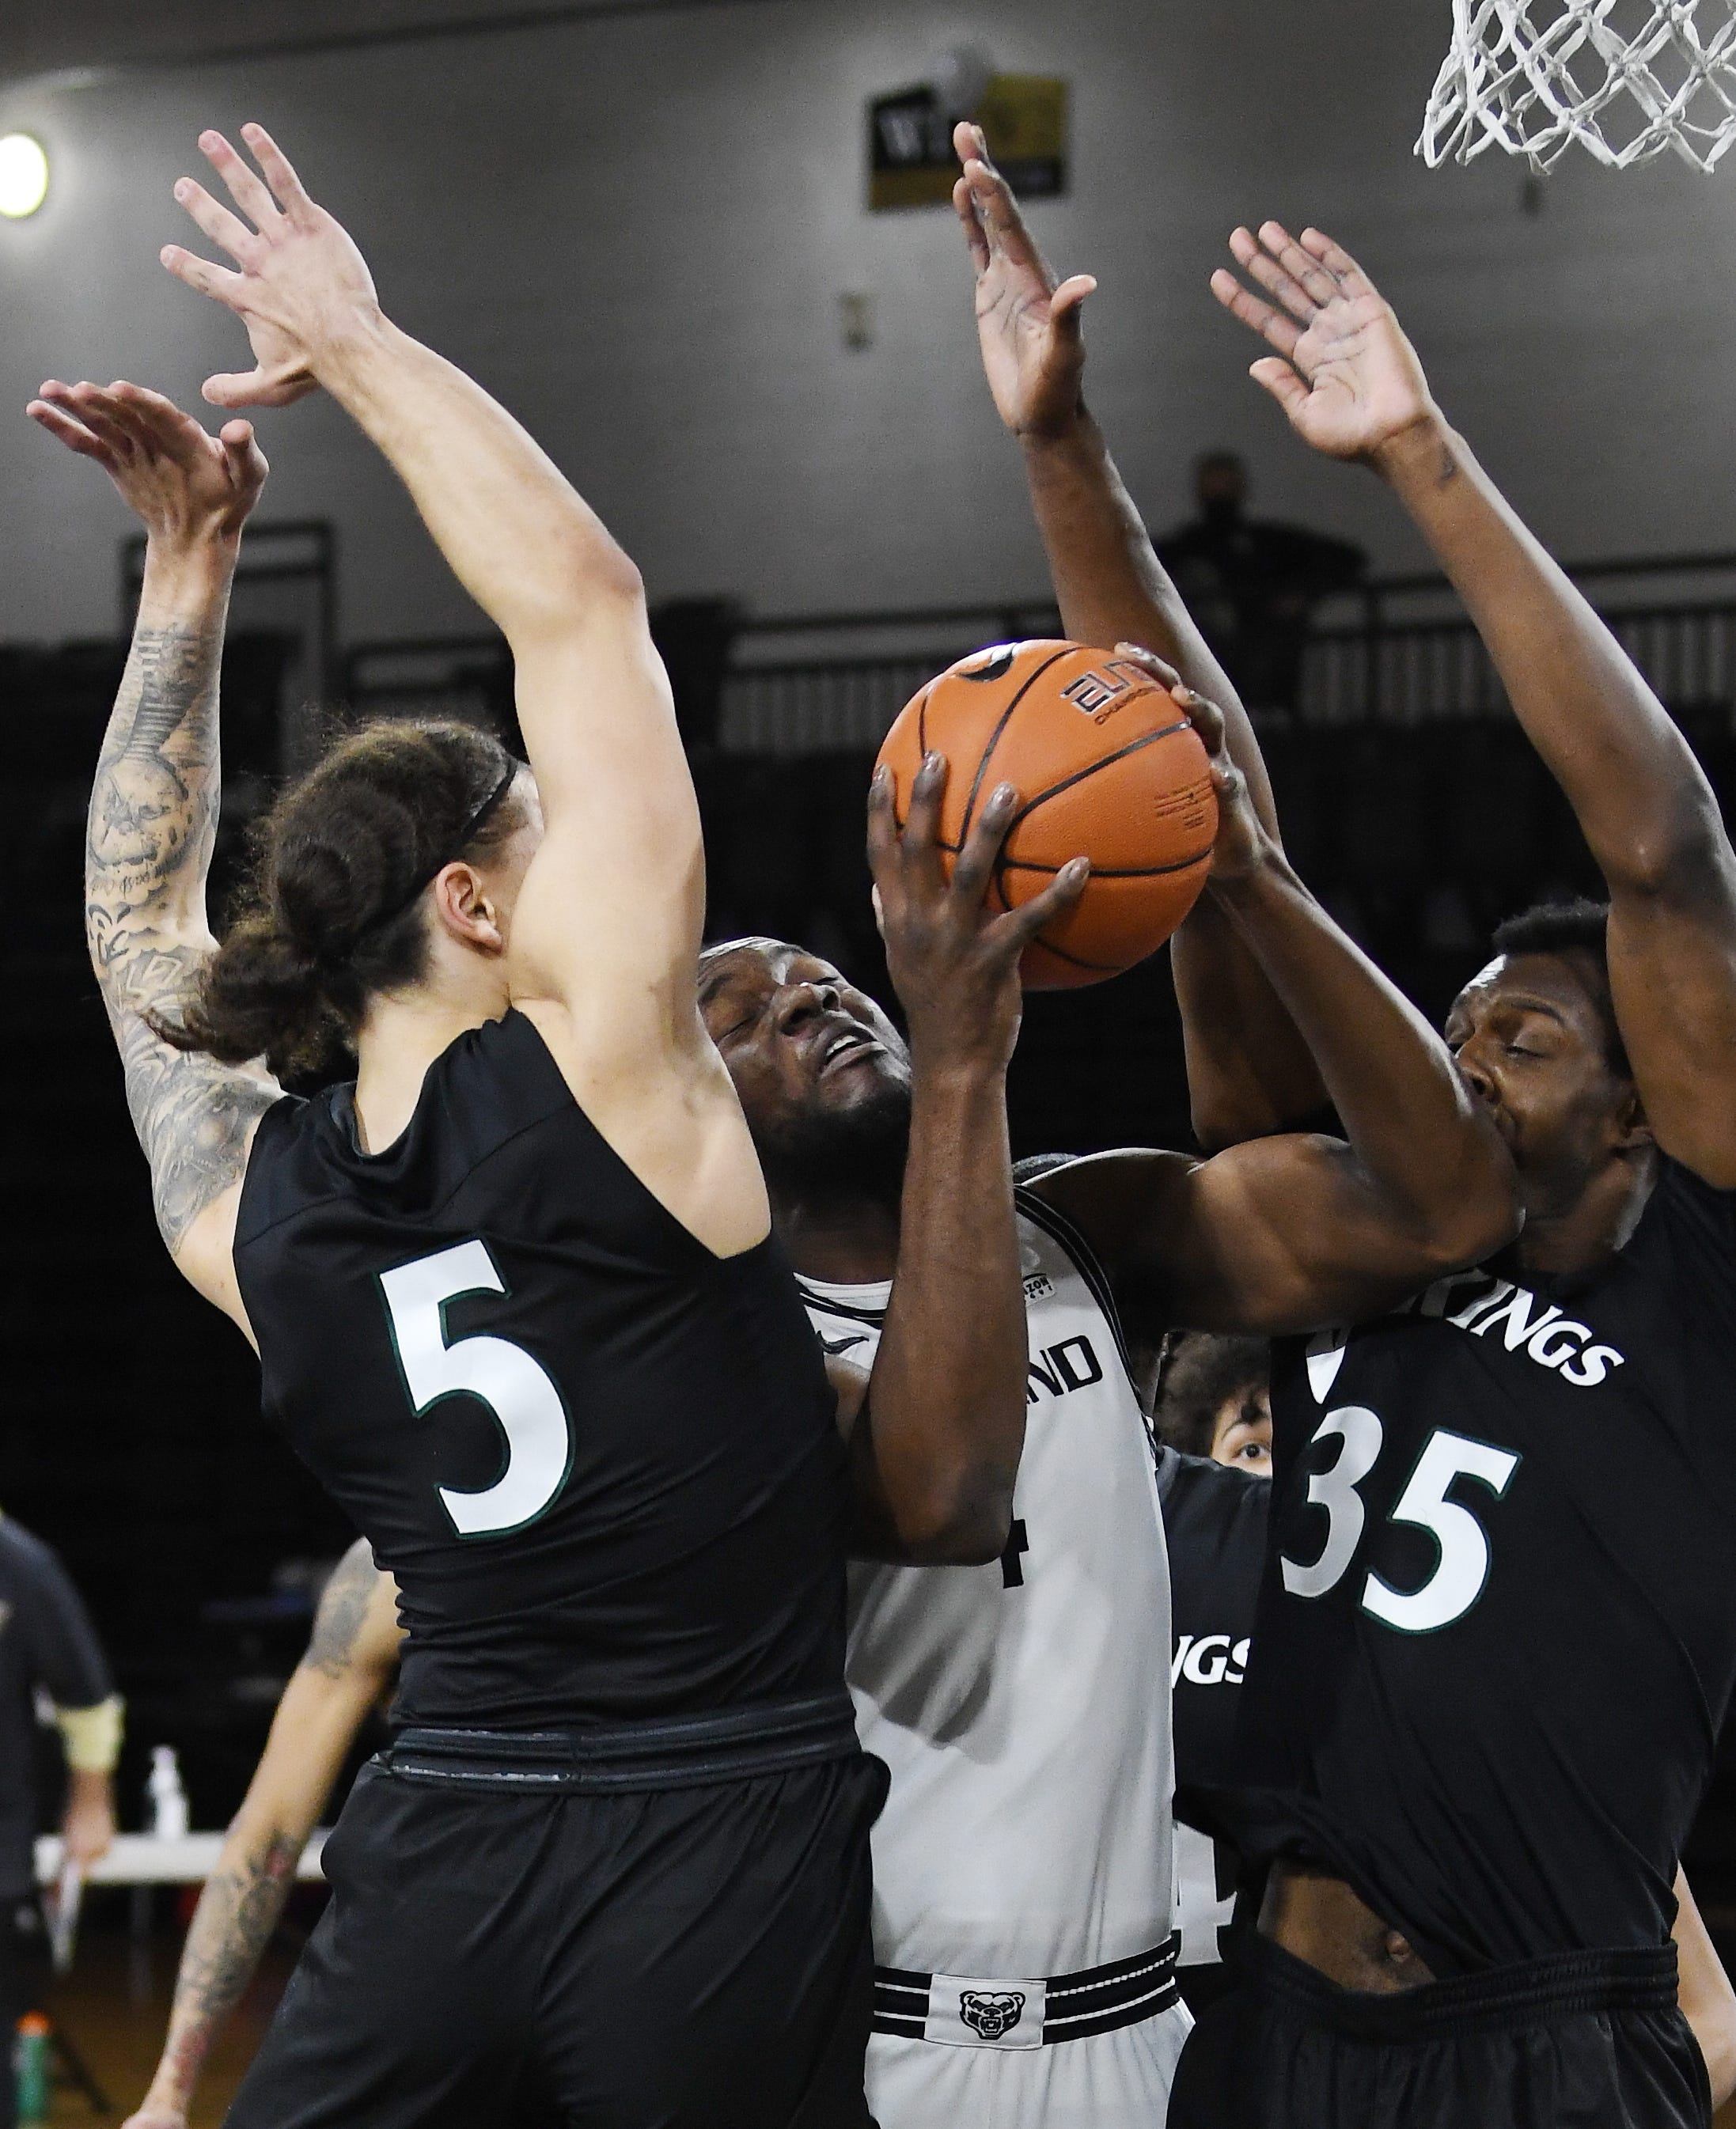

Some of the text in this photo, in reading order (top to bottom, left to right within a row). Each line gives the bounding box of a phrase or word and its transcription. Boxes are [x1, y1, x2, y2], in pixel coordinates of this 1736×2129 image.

[375, 1236, 576, 1539] 5
[1026, 1335, 1103, 1404] ND
[1279, 1404, 1522, 1635] 35
